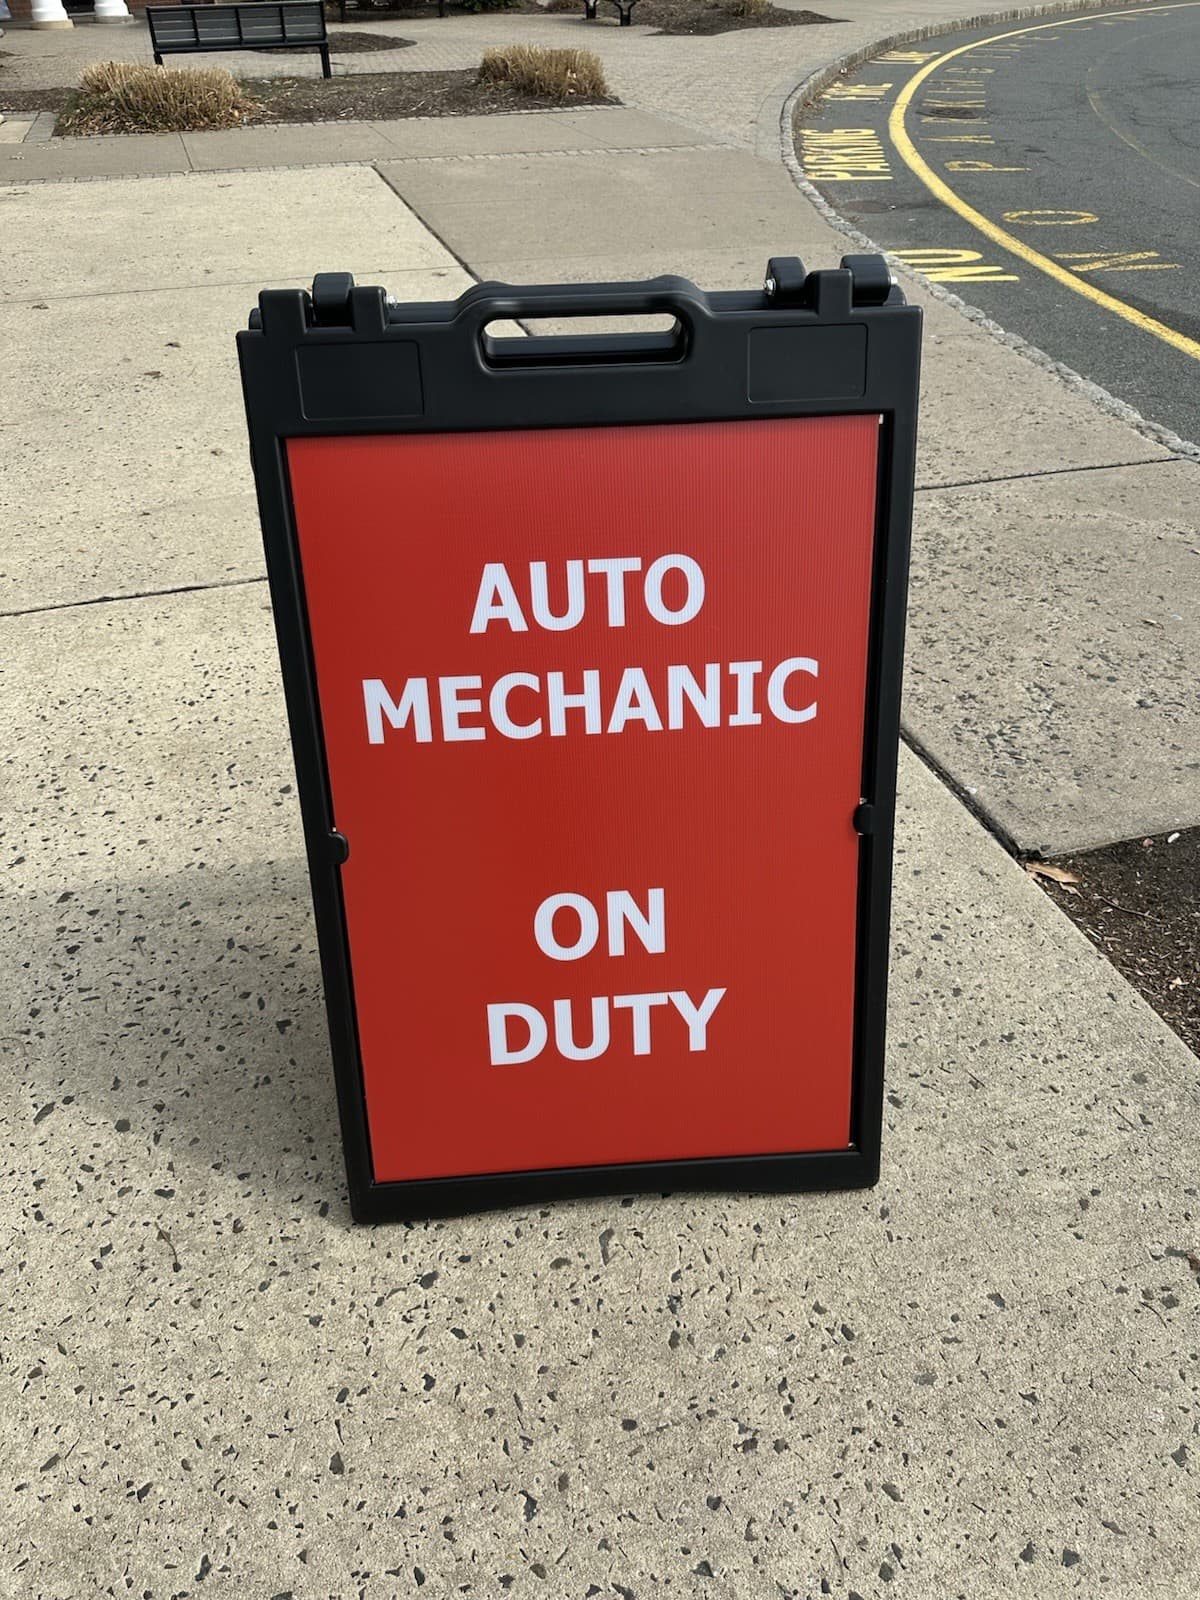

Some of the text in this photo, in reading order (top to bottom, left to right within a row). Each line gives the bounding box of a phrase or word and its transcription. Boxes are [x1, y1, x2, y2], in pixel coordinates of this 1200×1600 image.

[800, 128, 894, 181] PARKING
[919, 66, 1032, 172] PARKING
[884, 248, 1020, 282] NO
[1002, 209, 1184, 273] NO
[468, 552, 706, 635] AUTO
[361, 656, 819, 745] MECHANIC
[533, 887, 666, 961] ON
[486, 987, 728, 1066] DUTY
